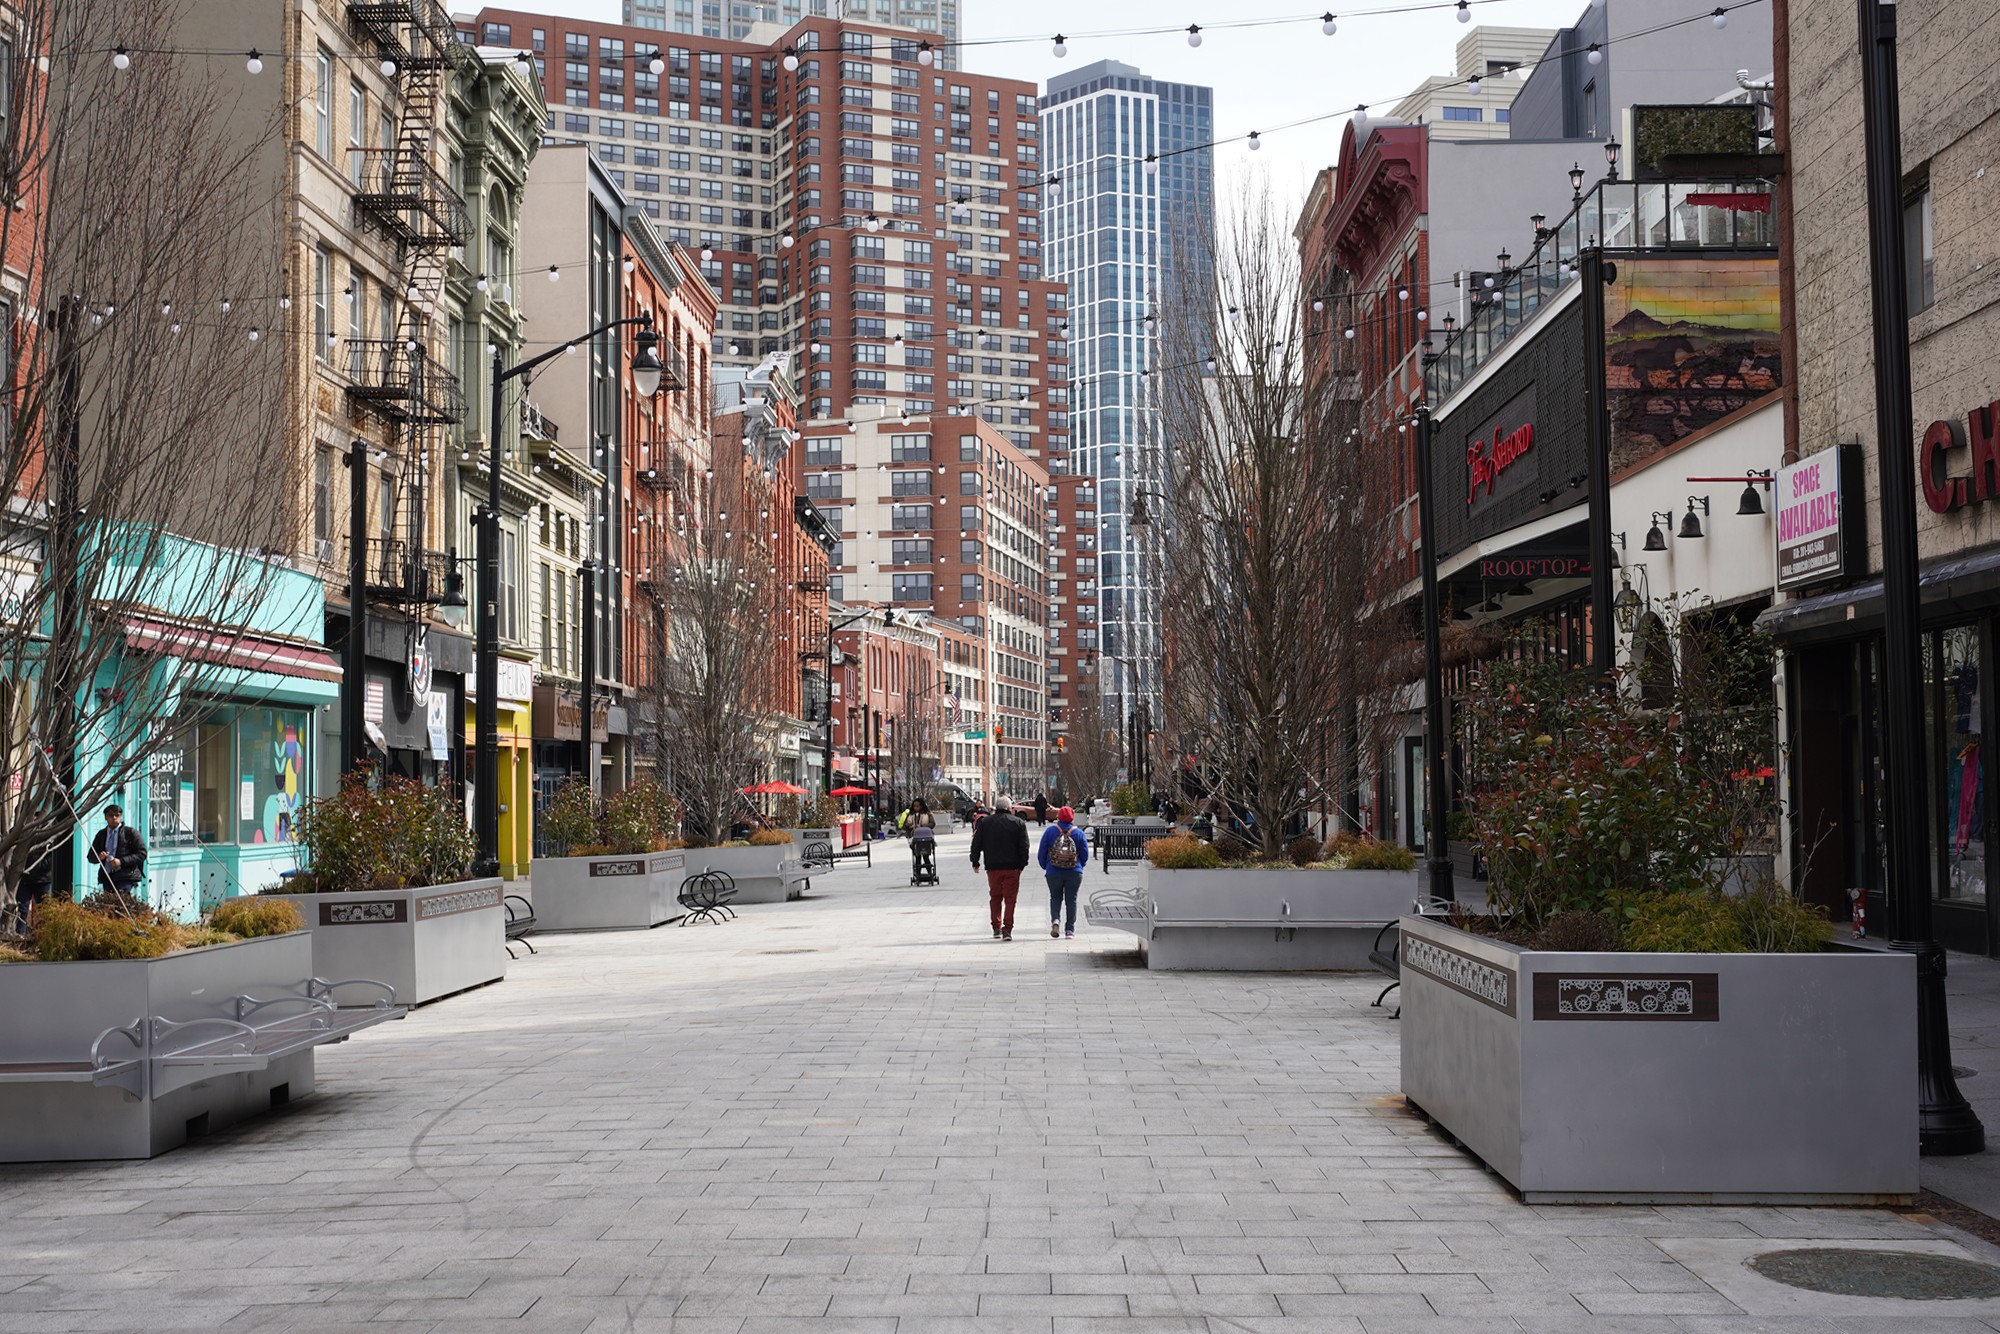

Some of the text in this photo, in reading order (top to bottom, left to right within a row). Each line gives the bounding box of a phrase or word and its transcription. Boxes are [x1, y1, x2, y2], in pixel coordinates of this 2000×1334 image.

[1486, 423, 1533, 495] ASHFORD
[1792, 463, 1821, 499] SPACE
[1779, 490, 1838, 543] AVAILABLE
[1482, 559, 1579, 578] ROOFTOP
[149, 749, 184, 776] ersey!
